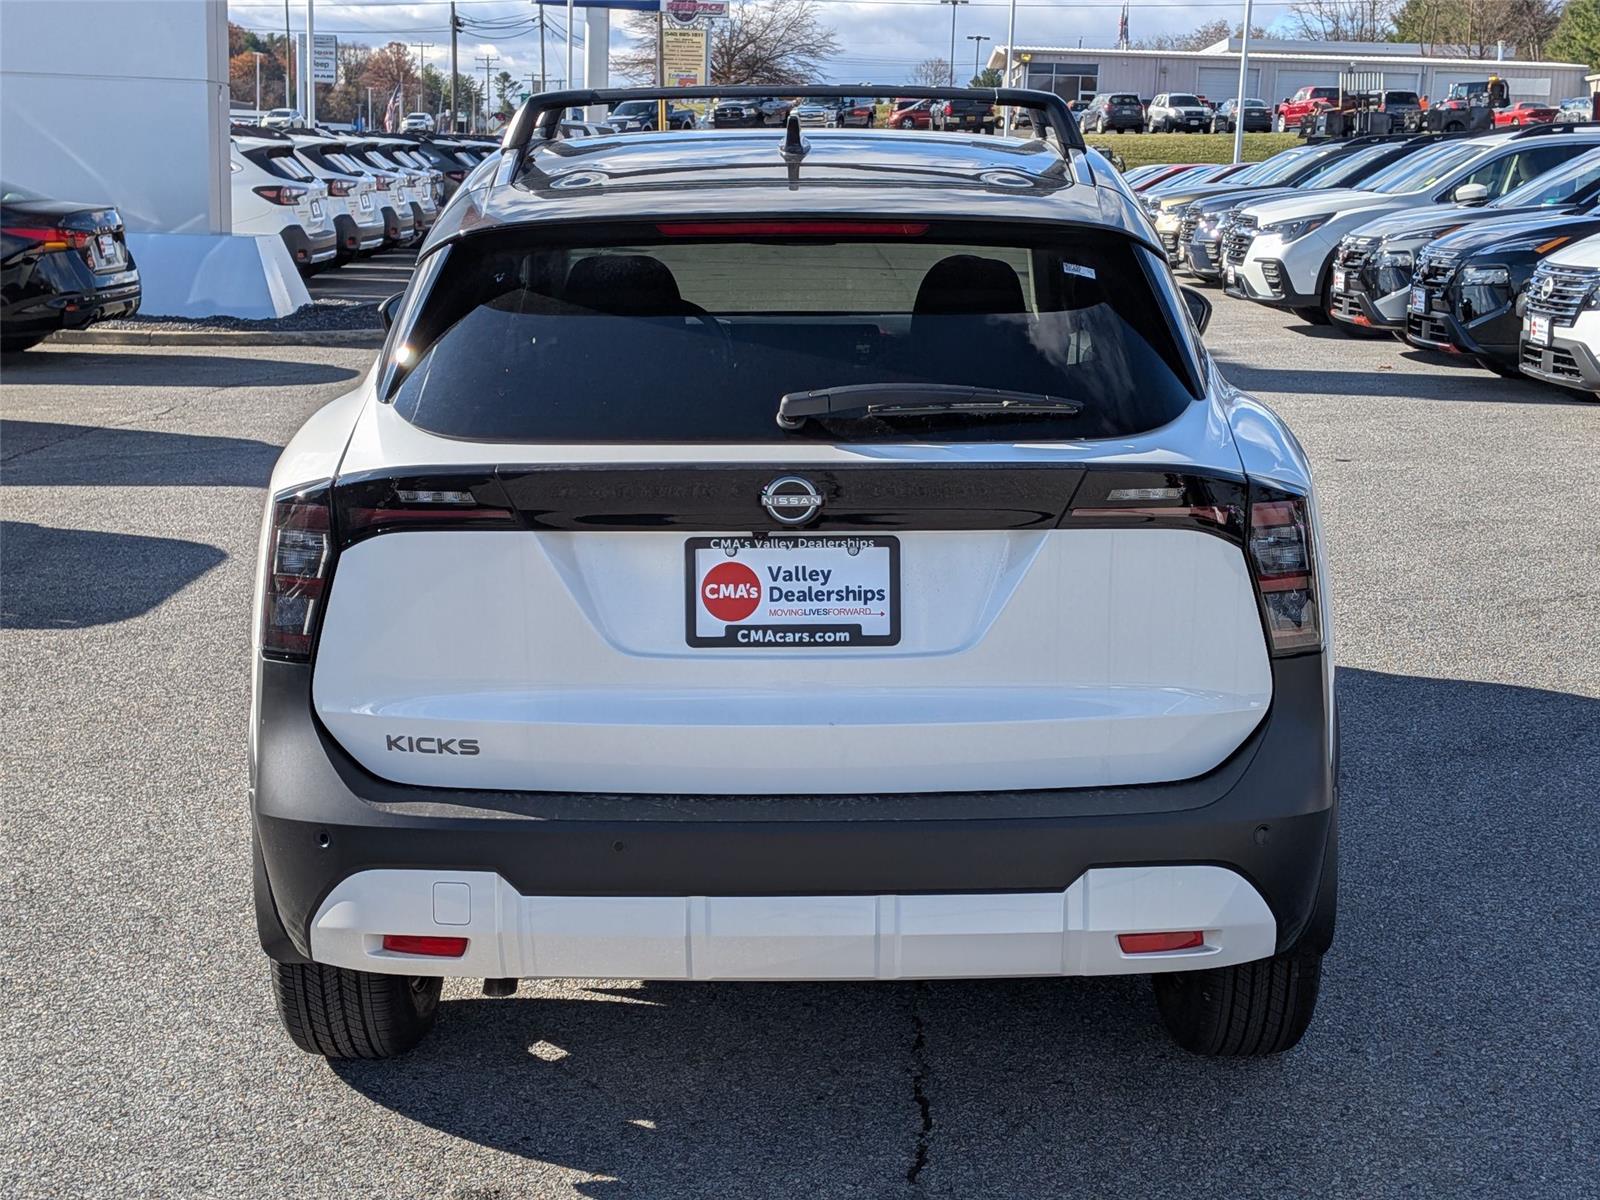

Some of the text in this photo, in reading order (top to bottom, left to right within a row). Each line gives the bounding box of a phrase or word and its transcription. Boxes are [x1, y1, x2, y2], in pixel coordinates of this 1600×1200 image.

[761, 496, 822, 506] NISSAN
[710, 537, 875, 552] CMA's Valley Dealerships
[767, 565, 833, 586] Valley
[705, 583, 759, 600] CMA's
[768, 585, 886, 606] Dealerships
[736, 628, 851, 643] CMAcars.com
[385, 733, 481, 756] KICKS
